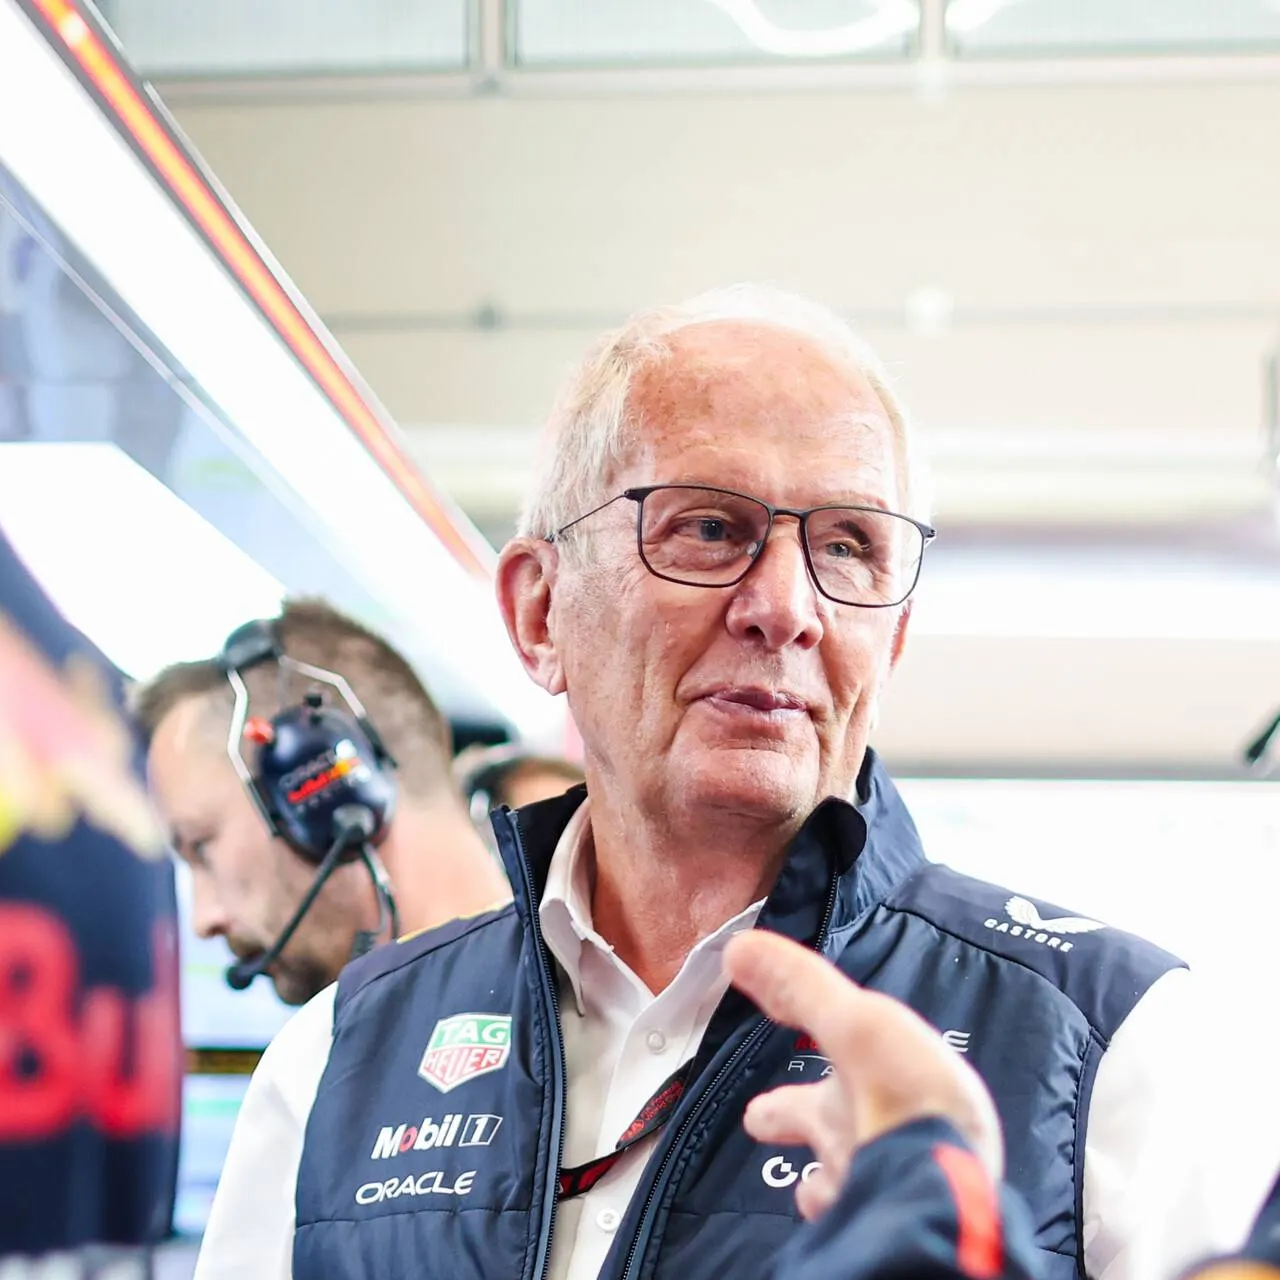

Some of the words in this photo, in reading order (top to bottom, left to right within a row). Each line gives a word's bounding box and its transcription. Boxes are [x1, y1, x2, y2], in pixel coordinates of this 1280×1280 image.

[440, 1020, 510, 1046] TAG
[424, 1047, 502, 1084] HEUER
[370, 1113, 463, 1160] Mobil
[354, 1170, 478, 1206] ORACLE
